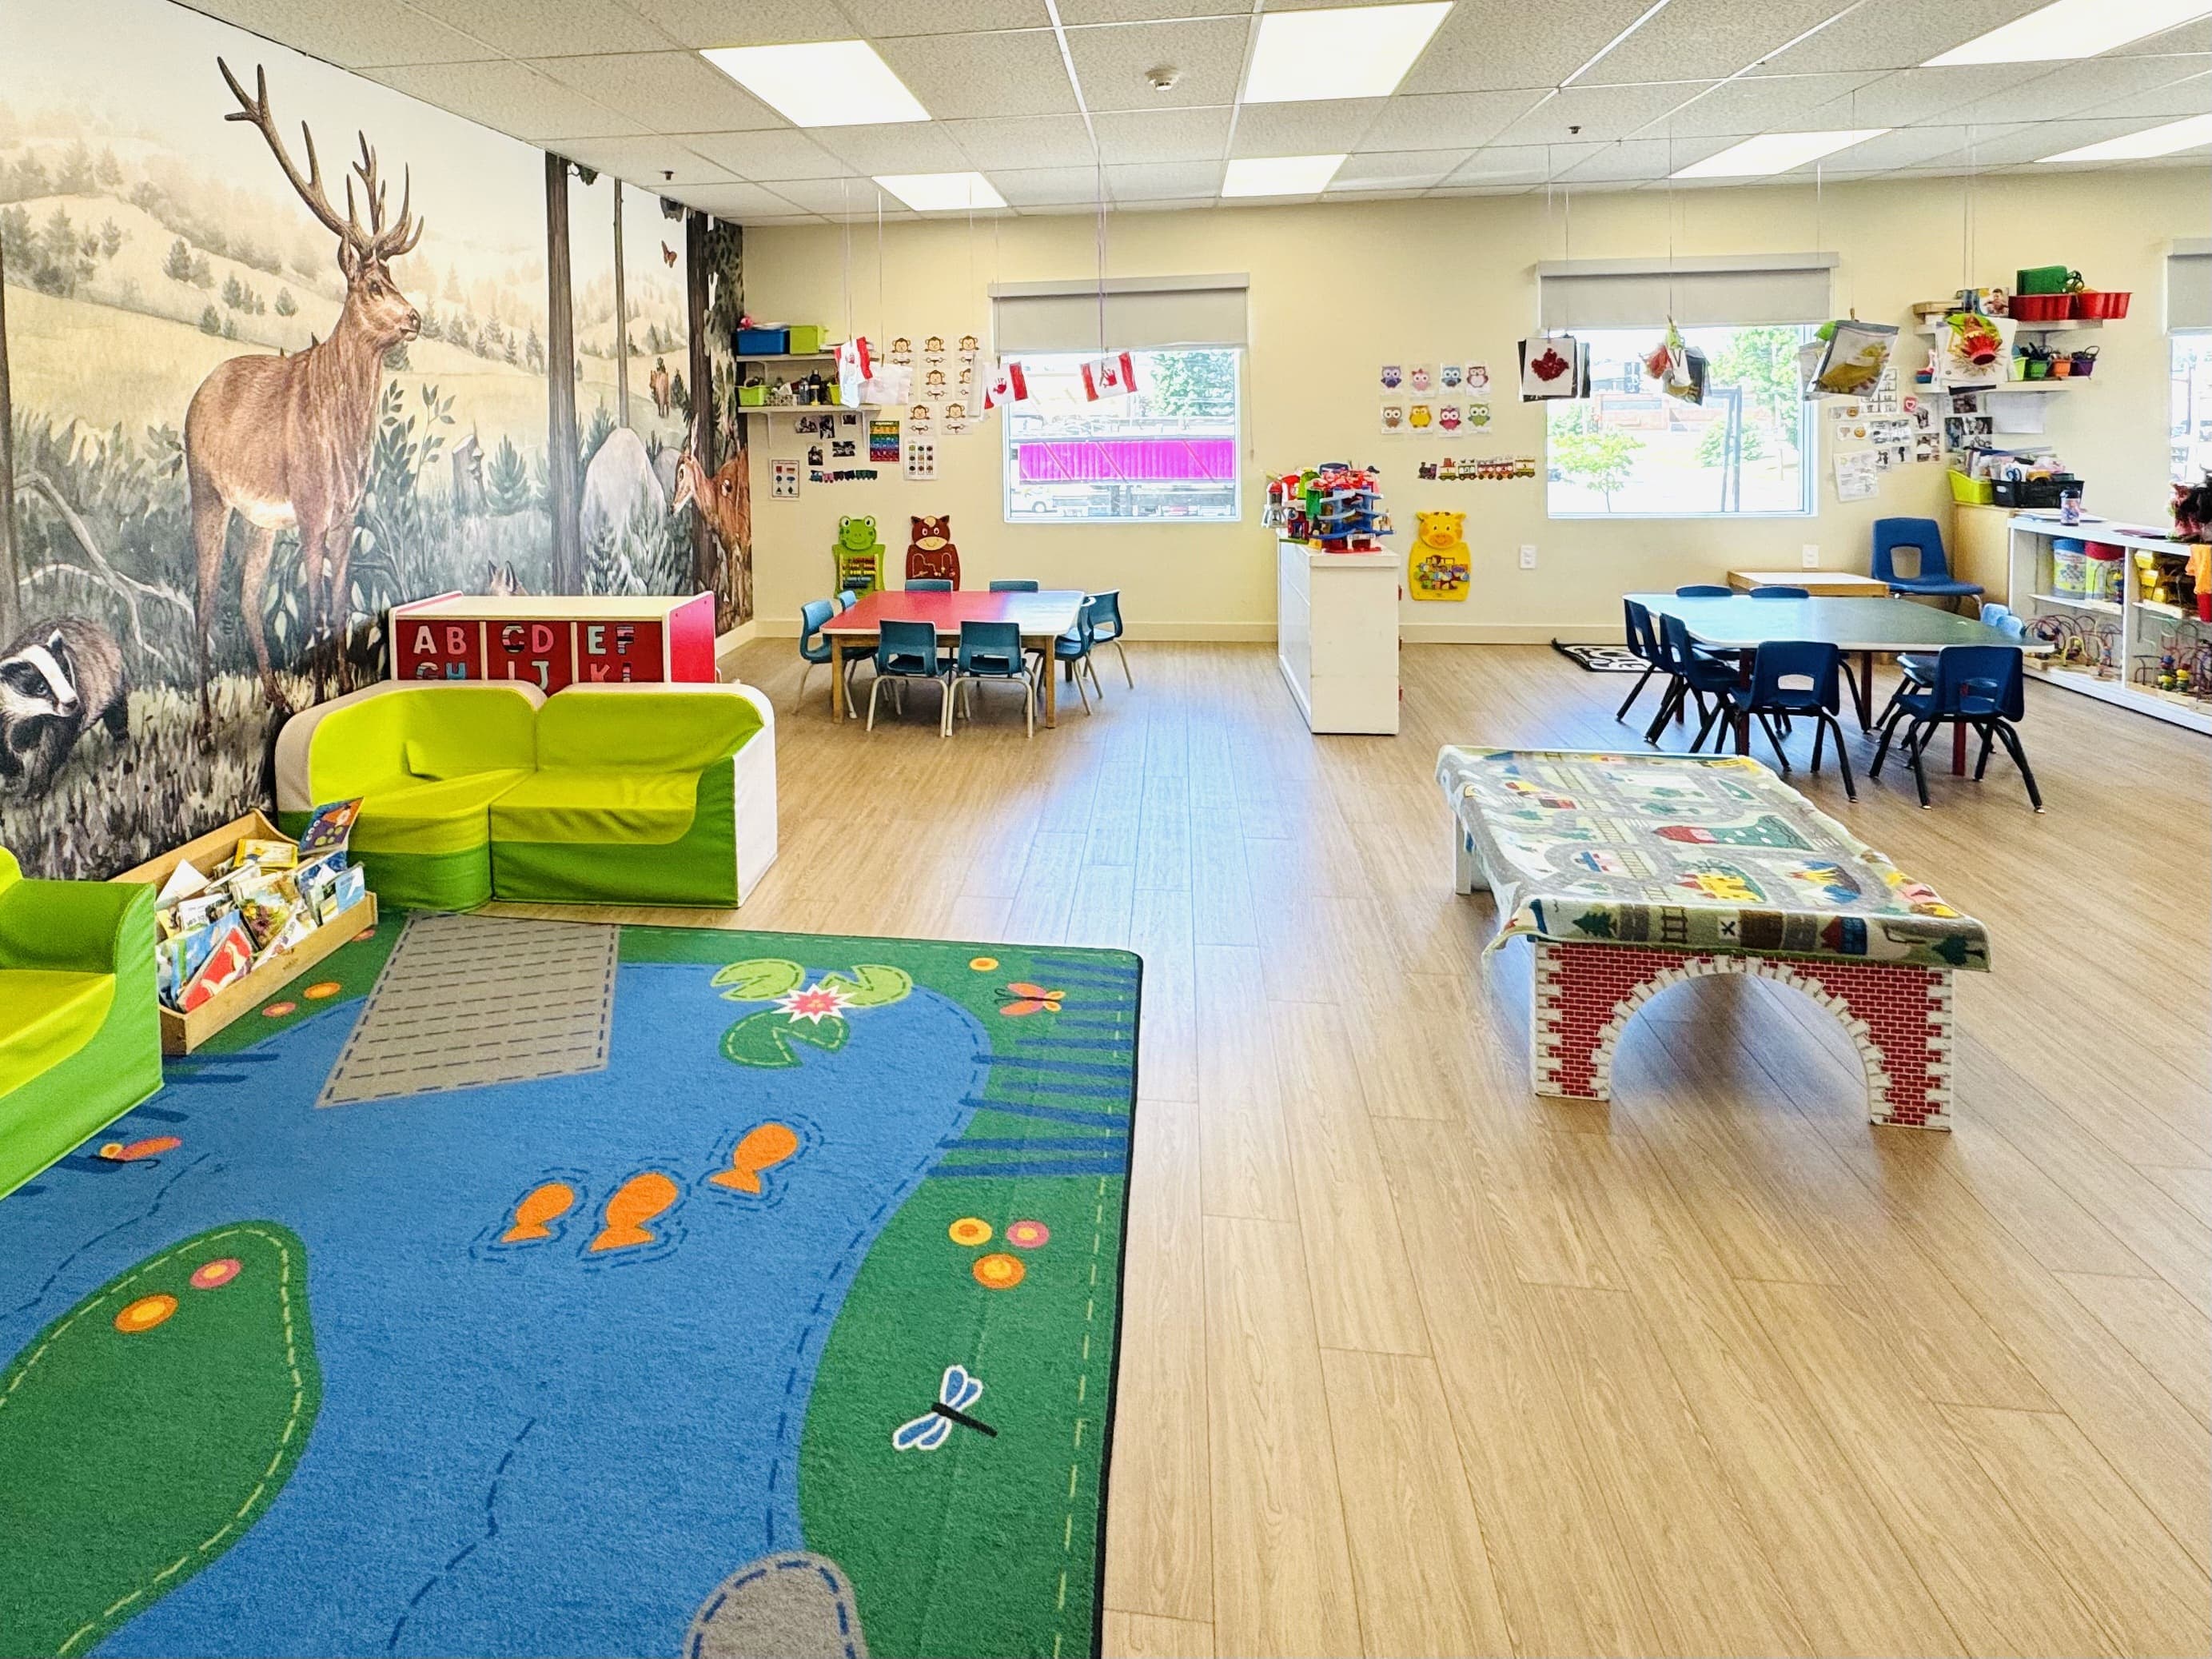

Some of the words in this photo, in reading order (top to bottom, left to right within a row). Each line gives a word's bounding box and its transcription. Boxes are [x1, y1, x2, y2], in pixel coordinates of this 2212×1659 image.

[413, 625, 438, 655] A
[446, 626, 468, 656] B
[501, 624, 525, 653] C
[531, 624, 555, 654] D
[587, 625, 607, 655] E
[616, 624, 635, 654] F
